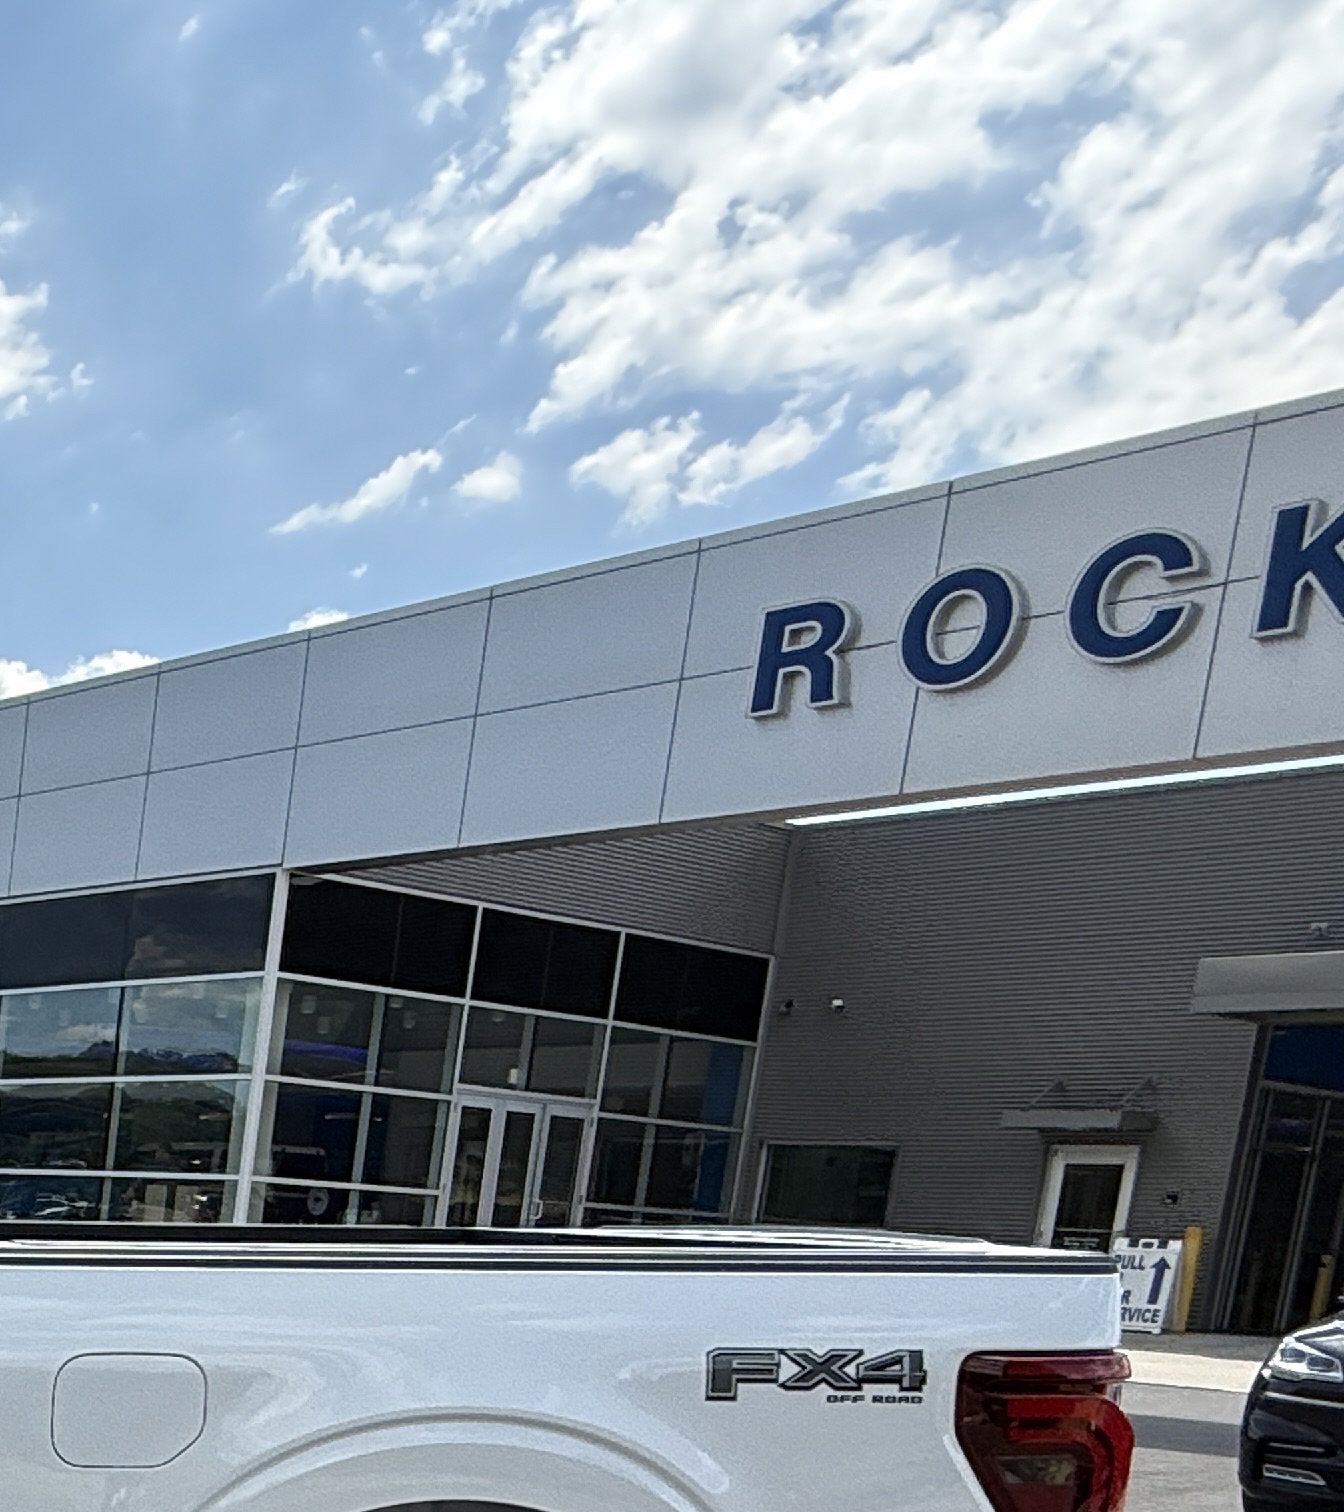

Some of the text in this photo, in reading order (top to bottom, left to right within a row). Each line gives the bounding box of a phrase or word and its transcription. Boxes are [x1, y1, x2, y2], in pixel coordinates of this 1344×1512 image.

[1120, 1307, 1162, 1324] RVICE
[705, 1346, 928, 1401] FX4
[826, 1394, 924, 1404] OFF ROAD
